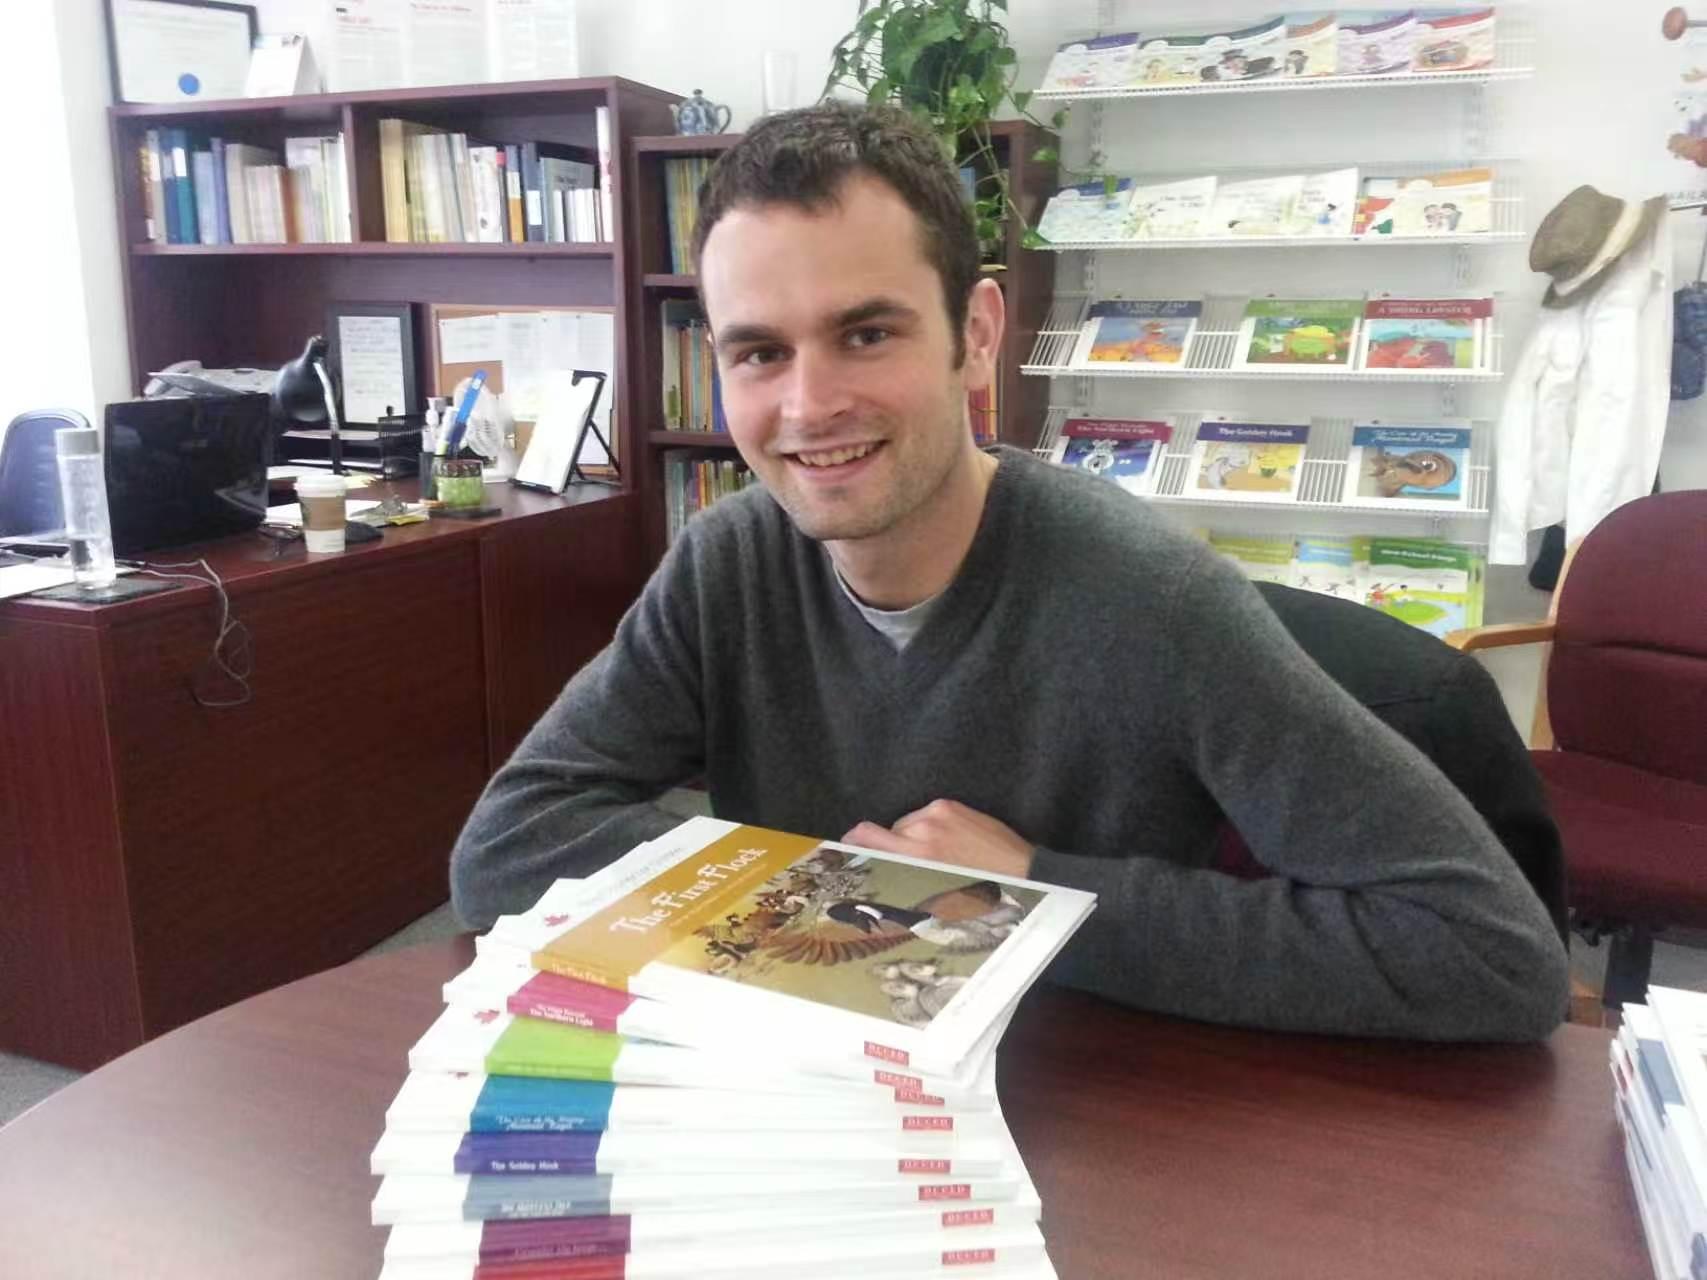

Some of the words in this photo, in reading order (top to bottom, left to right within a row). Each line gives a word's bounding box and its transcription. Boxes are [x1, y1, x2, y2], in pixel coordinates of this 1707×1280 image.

[1219, 427, 1235, 435] The
[609, 909, 673, 934] The
[651, 878, 719, 909] First
[697, 846, 769, 881] Flock
[491, 1161, 506, 1171] The
